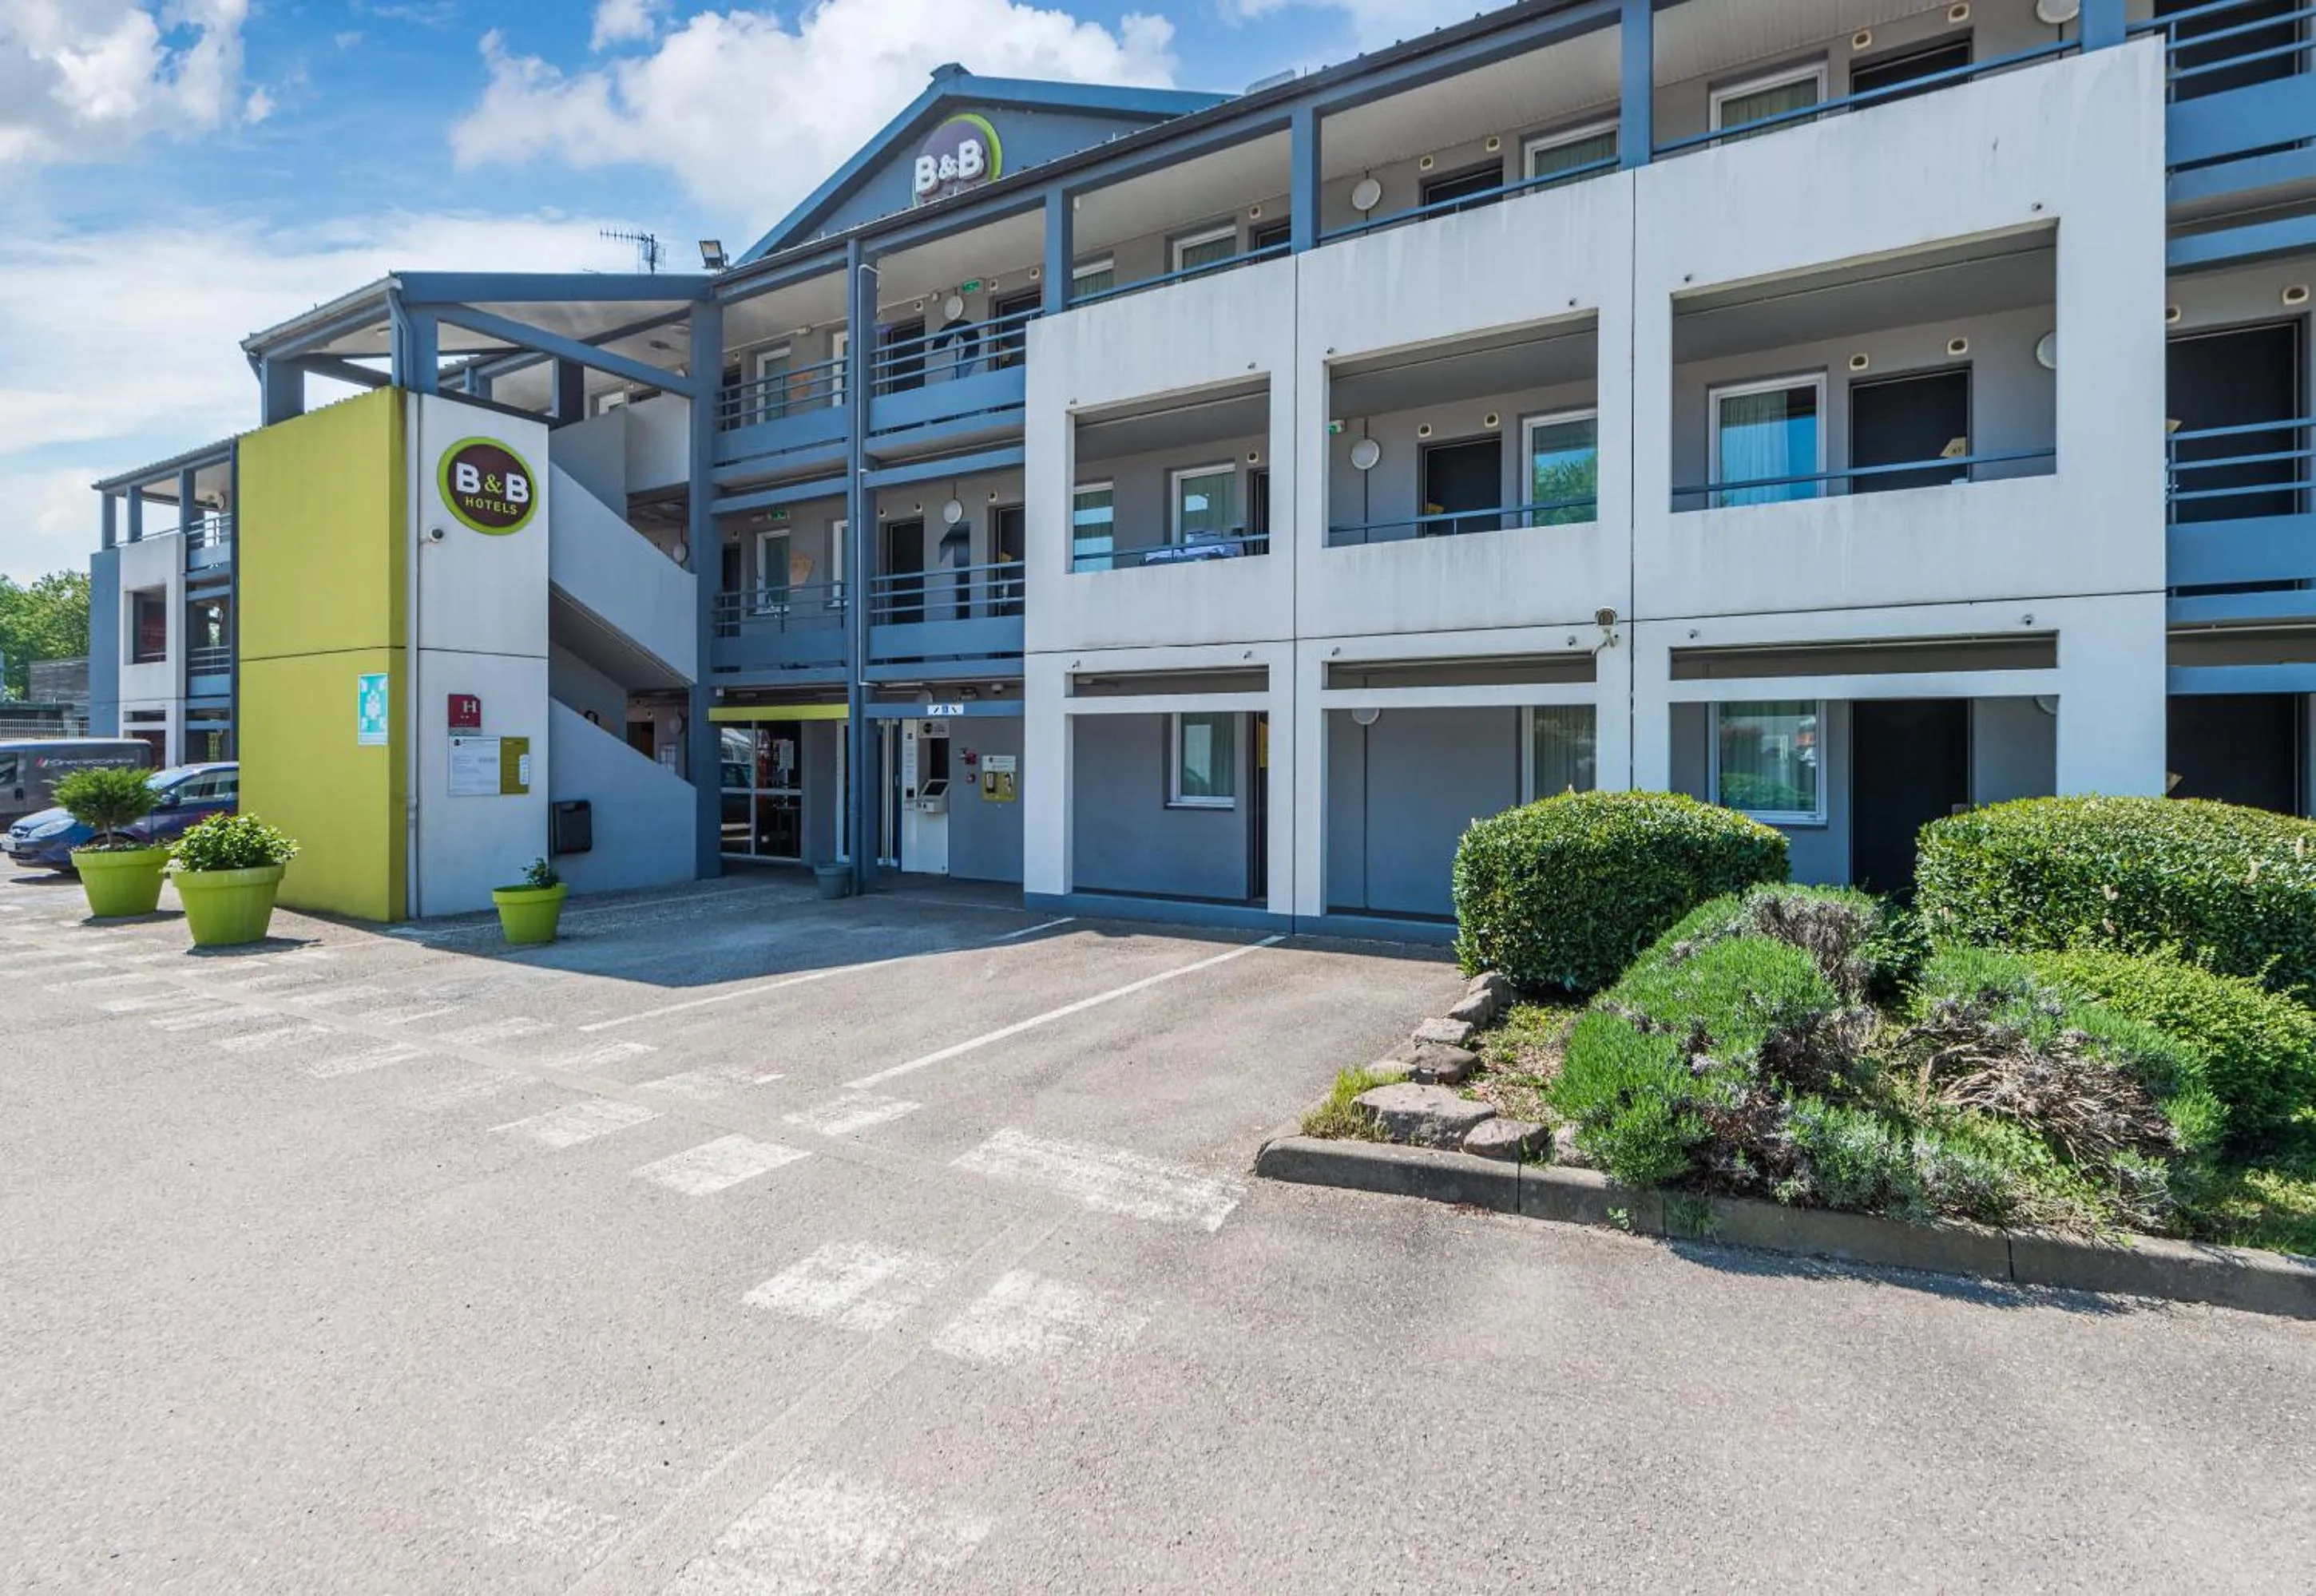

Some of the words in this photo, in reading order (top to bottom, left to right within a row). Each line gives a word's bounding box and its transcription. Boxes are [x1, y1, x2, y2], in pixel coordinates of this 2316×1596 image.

[914, 139, 985, 196] B&B
[456, 461, 529, 503] B&B
[465, 495, 518, 516] HOTELS
[462, 699, 478, 714] H
